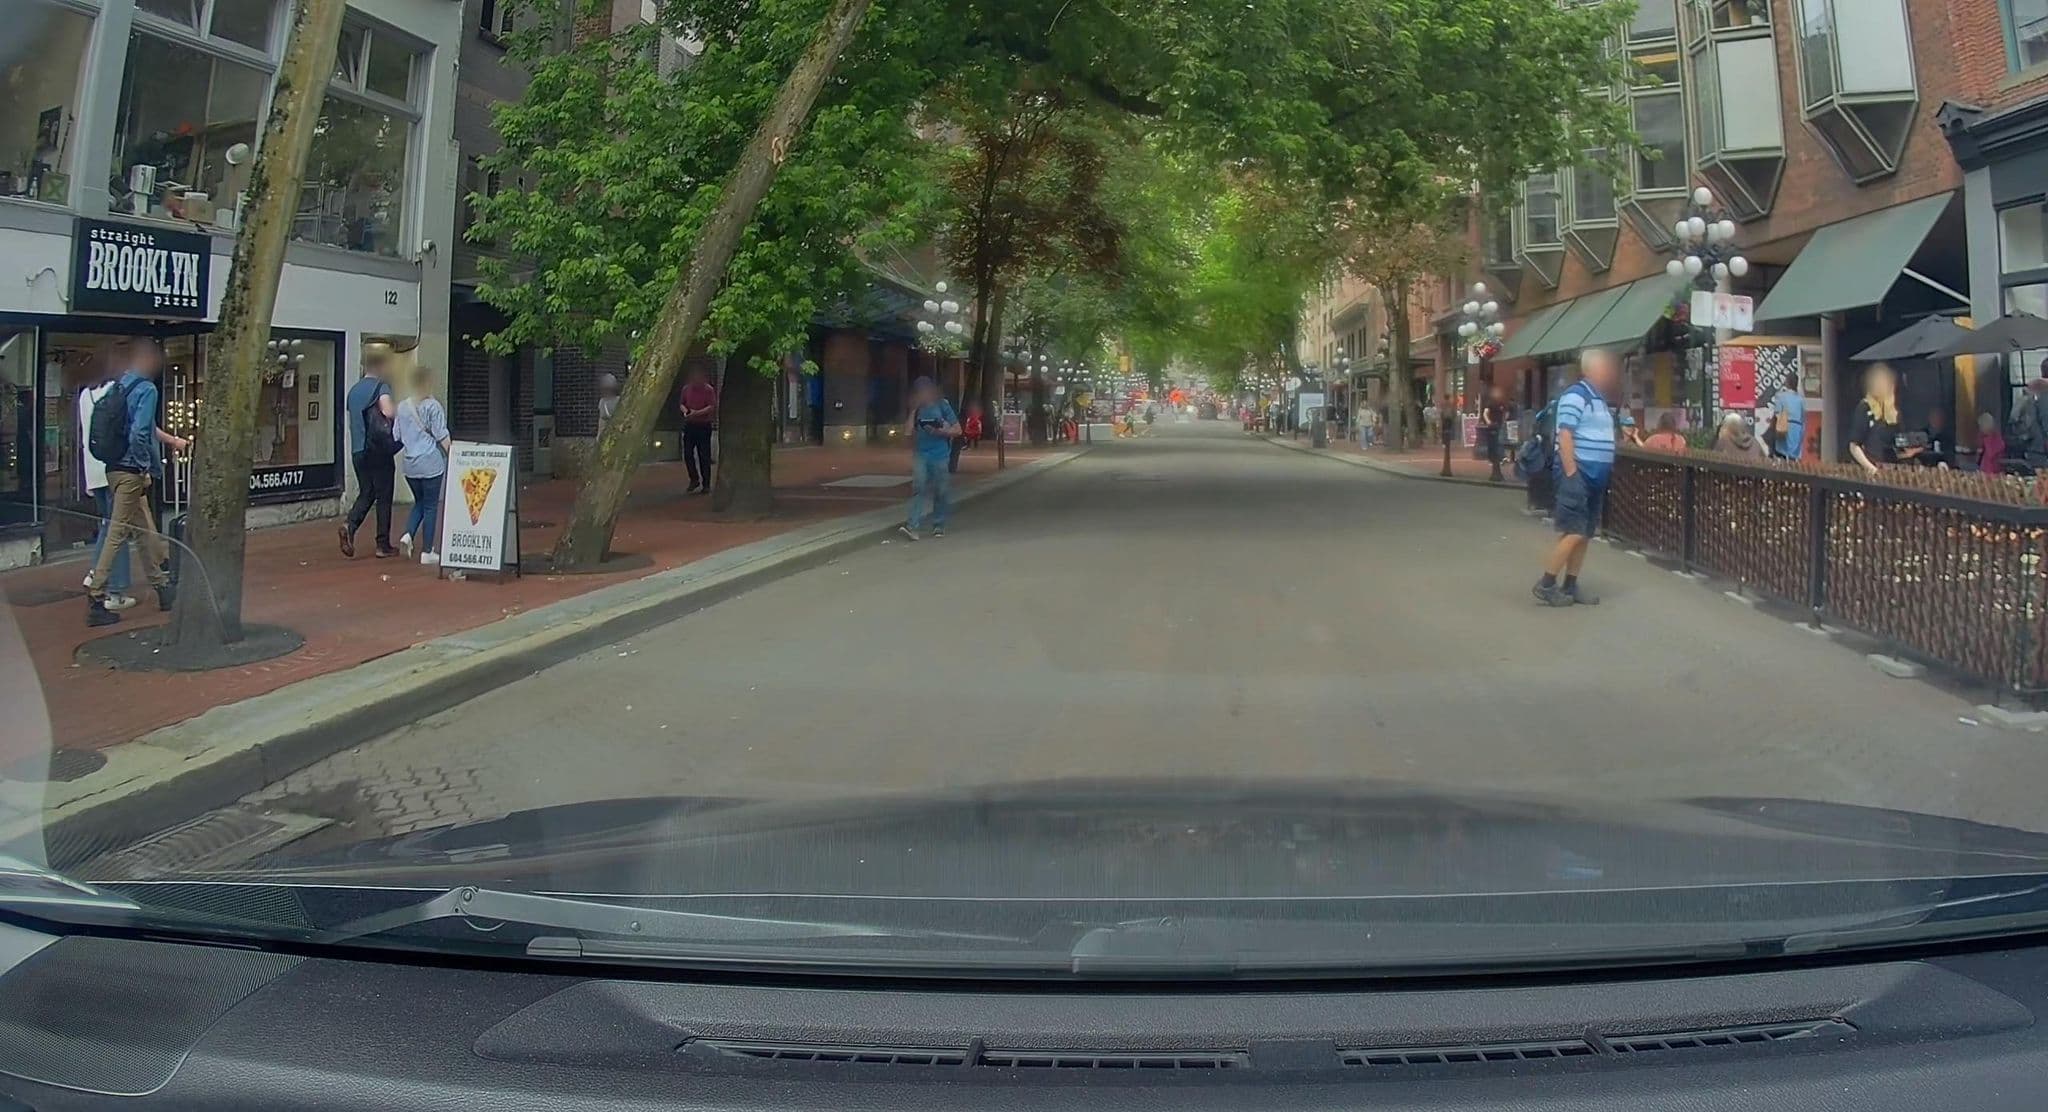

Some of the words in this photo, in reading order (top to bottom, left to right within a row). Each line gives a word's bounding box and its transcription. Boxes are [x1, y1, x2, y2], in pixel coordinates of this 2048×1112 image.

[90, 228, 155, 246] straight
[87, 241, 199, 297] BROOKLYN
[153, 295, 198, 308] pizza
[384, 290, 398, 305] 122
[249, 470, 304, 489] 04.566.4717
[452, 533, 493, 549] BROOKLYN
[449, 552, 494, 565] 604.566.4717
